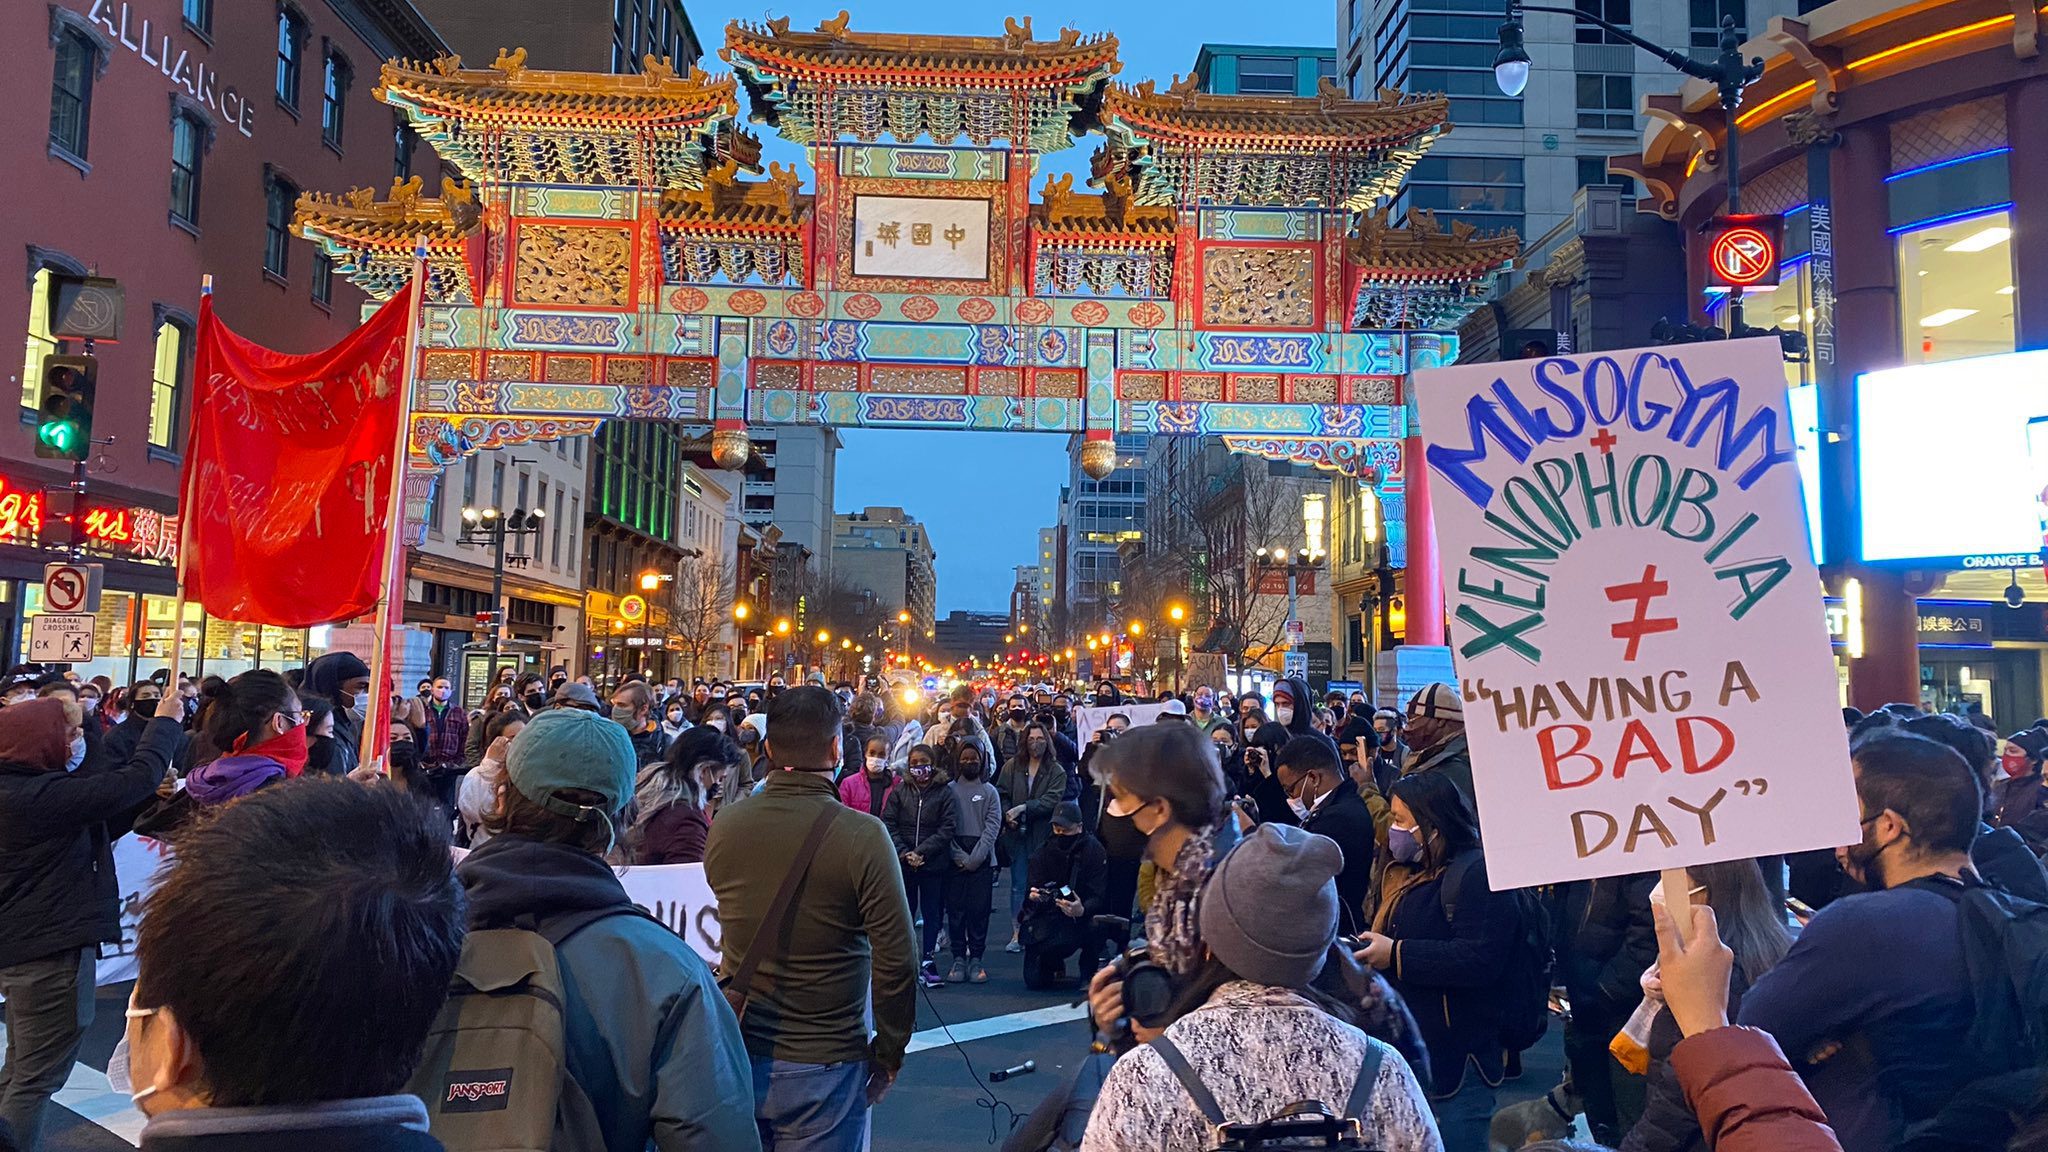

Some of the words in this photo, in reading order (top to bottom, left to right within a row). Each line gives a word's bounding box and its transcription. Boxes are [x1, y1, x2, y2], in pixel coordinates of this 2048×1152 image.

[88, 0, 253, 138] ALLIANCE
[1811, 205, 1835, 365] 美國娛樂公司
[1557, 331, 1570, 355] 美
[1455, 452, 1791, 664] XENOPHOBIA
[1963, 555, 2027, 567] ORANGE
[1917, 616, 1982, 632] 娛樂公司
[1189, 655, 1225, 671] ASIAN
[1287, 669, 1303, 679] 25
[1718, 660, 1760, 706] A
[1536, 716, 1735, 790] BAD
[447, 1081, 506, 1101] JANSPORT
